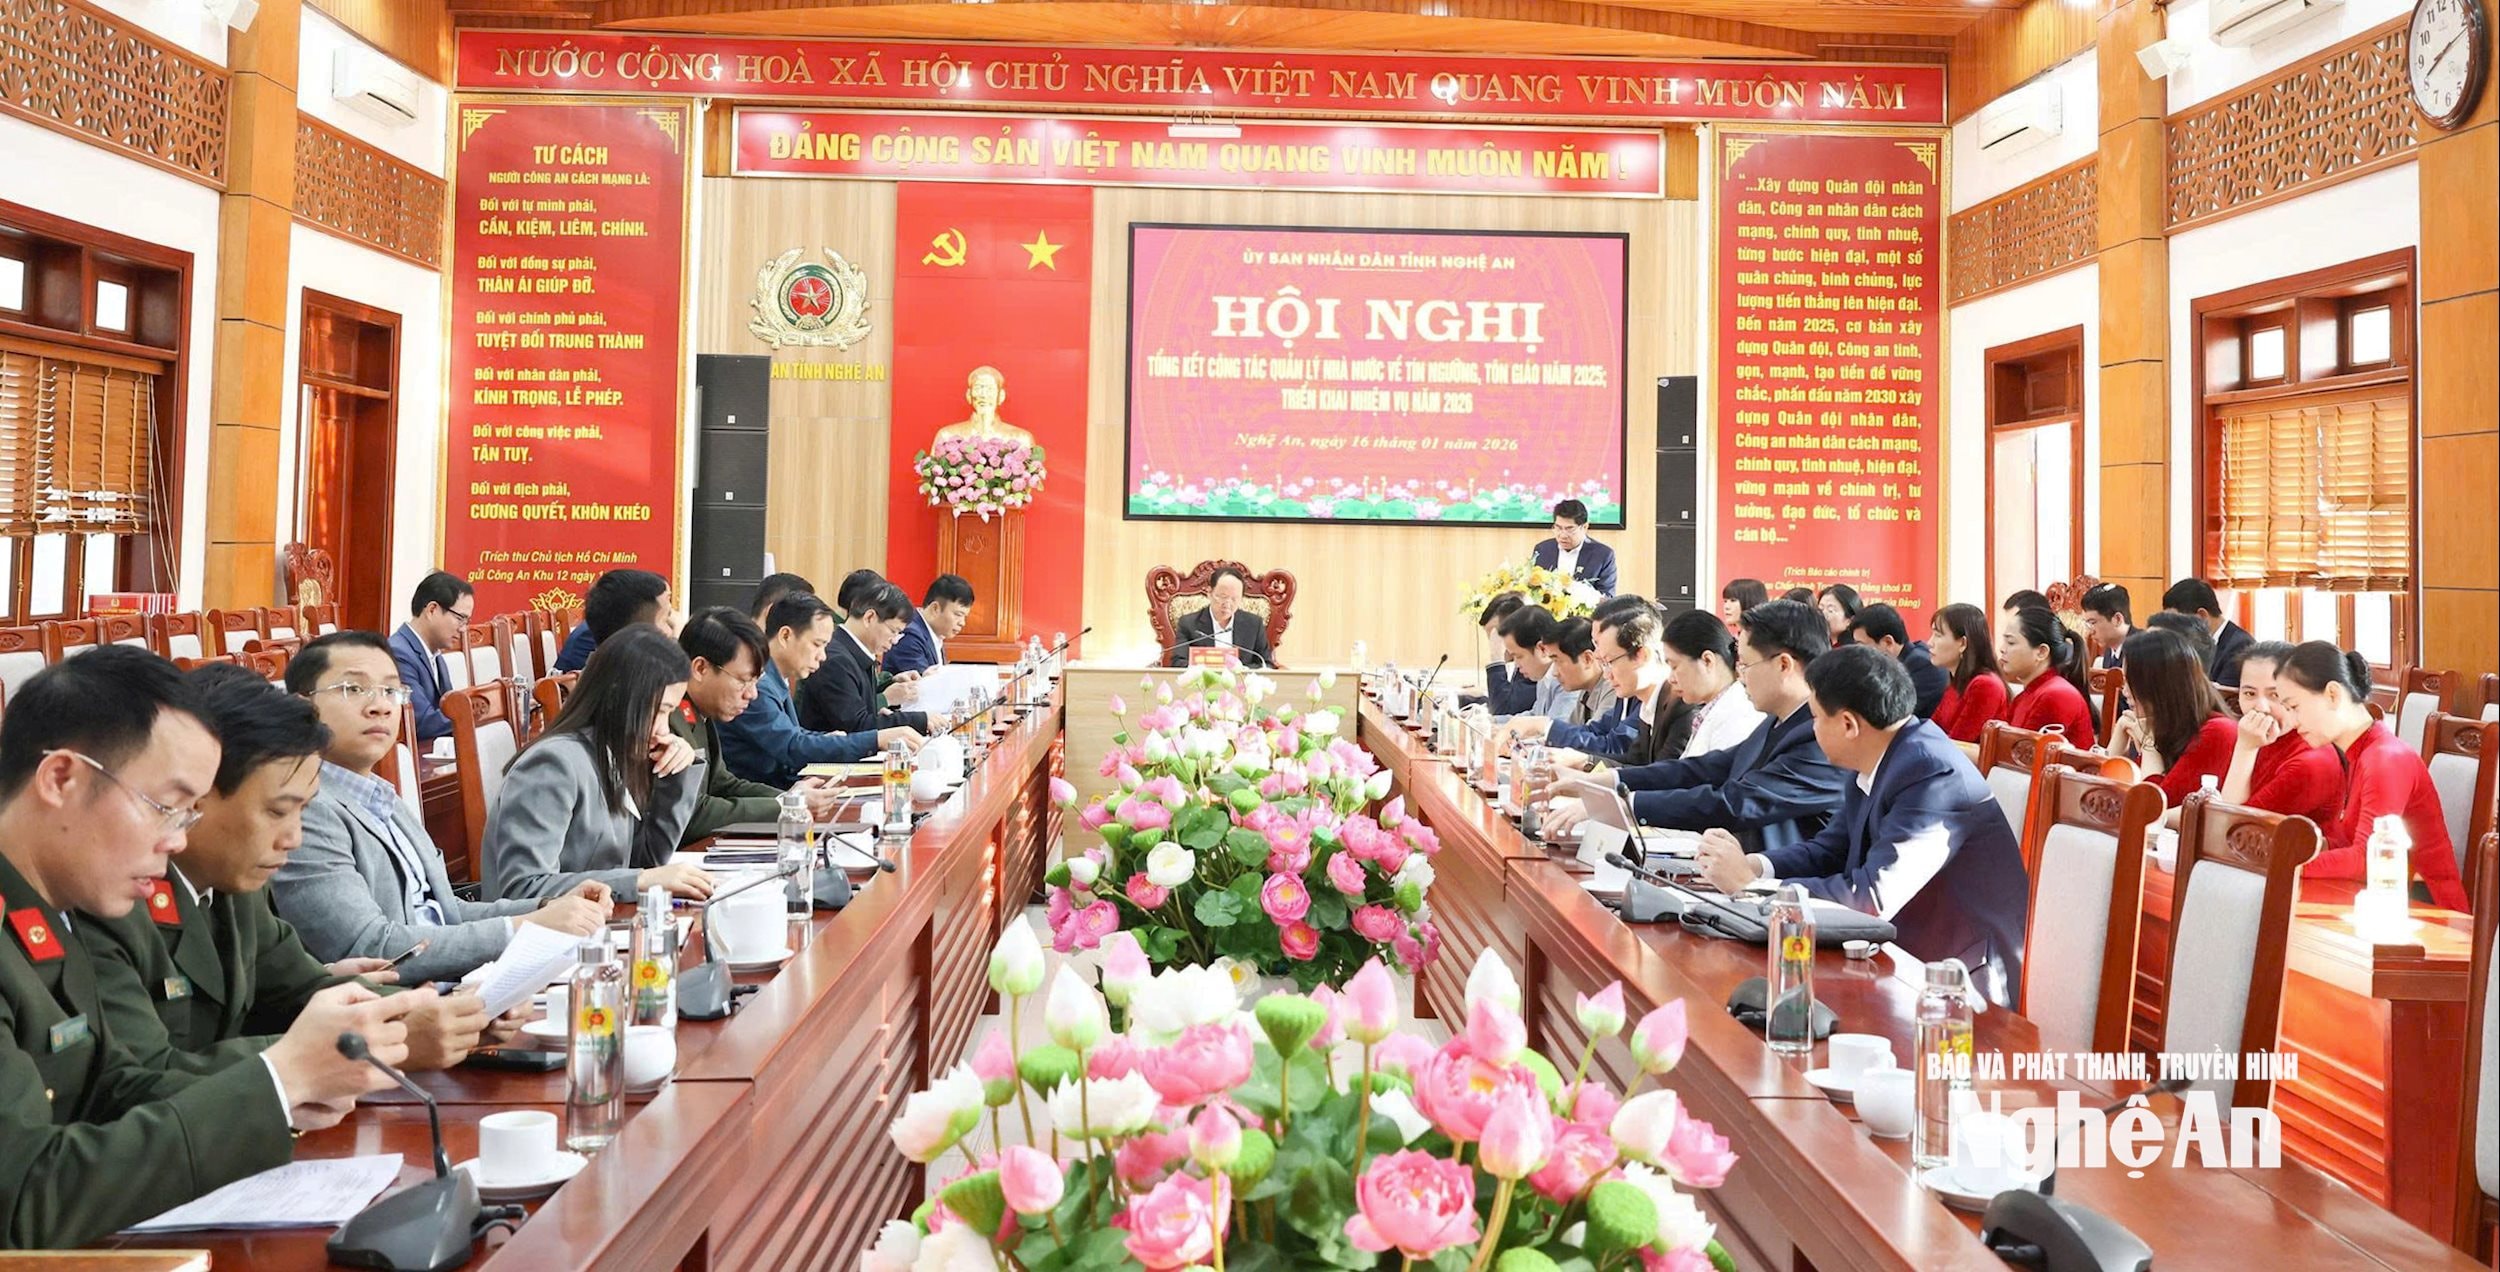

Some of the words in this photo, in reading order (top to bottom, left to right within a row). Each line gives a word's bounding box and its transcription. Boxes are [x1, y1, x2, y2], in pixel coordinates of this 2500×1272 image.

[2420, 30, 2430, 46] 10
[2418, 54, 2424, 70] 9
[495, 41, 605, 78] NƯỚC
[617, 45, 723, 88] CỘNG
[736, 48, 814, 84] HOÀ
[828, 50, 887, 86] XÃ
[903, 52, 972, 94] HỘI
[985, 52, 1069, 91] CHỦ
[1084, 58, 1212, 94] NGHĨA
[1222, 61, 1315, 103] VIỆT
[1329, 70, 1417, 100] NAM
[1430, 73, 1561, 105] QUANG
[1577, 75, 1680, 105] VINH
[1695, 71, 1805, 108] MUÔN
[1819, 73, 1907, 110] NĂM
[2433, 90, 2439, 104] 7
[2445, 92, 2452, 107] 6
[534, 145, 557, 164] TƯ
[561, 143, 607, 165] CÁCH
[769, 121, 861, 161] ĐẢNG
[872, 127, 959, 170] CỘNG
[970, 125, 1040, 166] SẢN
[1051, 131, 1121, 174] VIỆT
[1130, 142, 1209, 171] NAM
[1220, 143, 1329, 176] QUANG
[1341, 146, 1416, 176] VINH
[1427, 141, 1521, 177] MUÔN
[1532, 143, 1609, 179] NĂM
[489, 171, 520, 183] NGƯỜI
[523, 172, 551, 183] CÔNG
[554, 173, 568, 183] AN
[571, 172, 599, 184] CÁCH
[602, 174, 632, 186] MẠNG
[635, 173, 650, 184] LÀ:
[1788, 179, 1819, 195] dựng
[1826, 180, 1858, 194] Quân
[1865, 180, 1884, 197] đội
[1892, 181, 1923, 194] nhân
[480, 197, 498, 211] Đối
[502, 199, 519, 211] với
[522, 200, 534, 213] tự
[537, 199, 565, 211] mình
[569, 199, 596, 213] phải,
[1738, 200, 1765, 216] dân,
[1770, 201, 1802, 217] Công
[1807, 205, 1822, 215] an
[1828, 203, 1858, 216] nhân
[1864, 203, 1887, 217] dân
[1892, 204, 1922, 218] cách
[517, 218, 555, 237] KIỆM,
[560, 218, 597, 237] LIÊM,
[602, 219, 648, 236] CHÍNH.
[1243, 249, 1264, 264] ỦY
[1269, 252, 1303, 265] BAN
[1307, 251, 1355, 267] NHÂN
[1360, 252, 1395, 267] DÂN
[1400, 252, 1436, 267] TỈNH
[1441, 254, 1487, 271] NGHỆ
[1491, 257, 1515, 269] AN
[478, 276, 514, 292] THÂN
[518, 276, 532, 292] ÁI
[536, 276, 568, 293] GIÚP
[572, 276, 595, 293] ĐỠ.
[1738, 293, 1773, 310] lượng
[1776, 293, 1801, 308] tiến
[1804, 292, 1840, 310] thẳng
[1844, 296, 1863, 309] lên
[1867, 296, 1895, 313] hiện
[1898, 297, 1922, 313] đại.
[1212, 285, 1341, 348] HỘI
[1365, 299, 1545, 353] NGHỊ
[1737, 315, 1761, 331] Đến
[1769, 317, 1796, 331] năm
[1804, 318, 1839, 333] 2025,
[1846, 321, 1862, 333] cơ
[1869, 318, 1892, 333] bản
[1900, 320, 1922, 336] xây
[476, 331, 517, 350] TUYỆT
[521, 329, 544, 348] ĐỐI
[548, 334, 593, 348] TRUNG
[598, 332, 643, 349] THÀNH
[771, 362, 789, 379] AN
[792, 358, 823, 379] TỈNH
[825, 361, 862, 384] NGHỆ
[865, 364, 885, 380] AN
[1148, 348, 1179, 377] TỔNG
[1207, 353, 1241, 379] CÔNG
[1244, 354, 1267, 379] TÁC
[1270, 352, 1303, 381] QUẢN
[1305, 355, 1320, 380] LÝ
[1323, 356, 1348, 380] NHÀ
[1351, 357, 1385, 381] NƯỚC
[1405, 358, 1426, 382] TÍN
[1484, 359, 1509, 384] TÔN
[1511, 360, 1540, 384] GIÁO
[1542, 361, 1572, 385] NĂM
[474, 387, 508, 404] KÍNH
[512, 390, 561, 407] TRỌNG,
[566, 386, 581, 405] LỄ
[586, 388, 623, 405] PHÉP.
[1281, 382, 1317, 410] TRIỂN
[1319, 389, 1348, 410] KHAI
[1350, 387, 1390, 416] NHIỆM
[1393, 391, 1410, 416] VỤ
[1412, 388, 1441, 413] NĂM
[1443, 392, 1473, 413] 2026
[1736, 410, 1769, 427] dựng
[1778, 411, 1812, 426] Quân
[1821, 412, 1842, 428] đội
[1851, 413, 1884, 426] nhân
[1893, 413, 1921, 429] dân,
[1234, 433, 1276, 448] Nghệ
[1280, 435, 1305, 447] An,
[1310, 436, 1347, 450] ngày
[1352, 436, 1369, 447] 16
[1373, 436, 1417, 451] tháng
[1421, 437, 1439, 449] 01
[1444, 439, 1477, 449] năm
[1482, 438, 1518, 451] 2026
[472, 444, 499, 464] TẬN
[471, 503, 518, 519] CƯƠNG
[522, 501, 567, 521] QUYẾT,
[572, 503, 609, 520] KHÔN
[614, 503, 650, 520] KHÉO
[512, 552, 530, 561] thư
[531, 551, 552, 562] Chủ
[554, 552, 573, 563] tịch
[576, 551, 590, 562] Hồ
[593, 552, 611, 562] Chí
[612, 552, 637, 562] Minh
